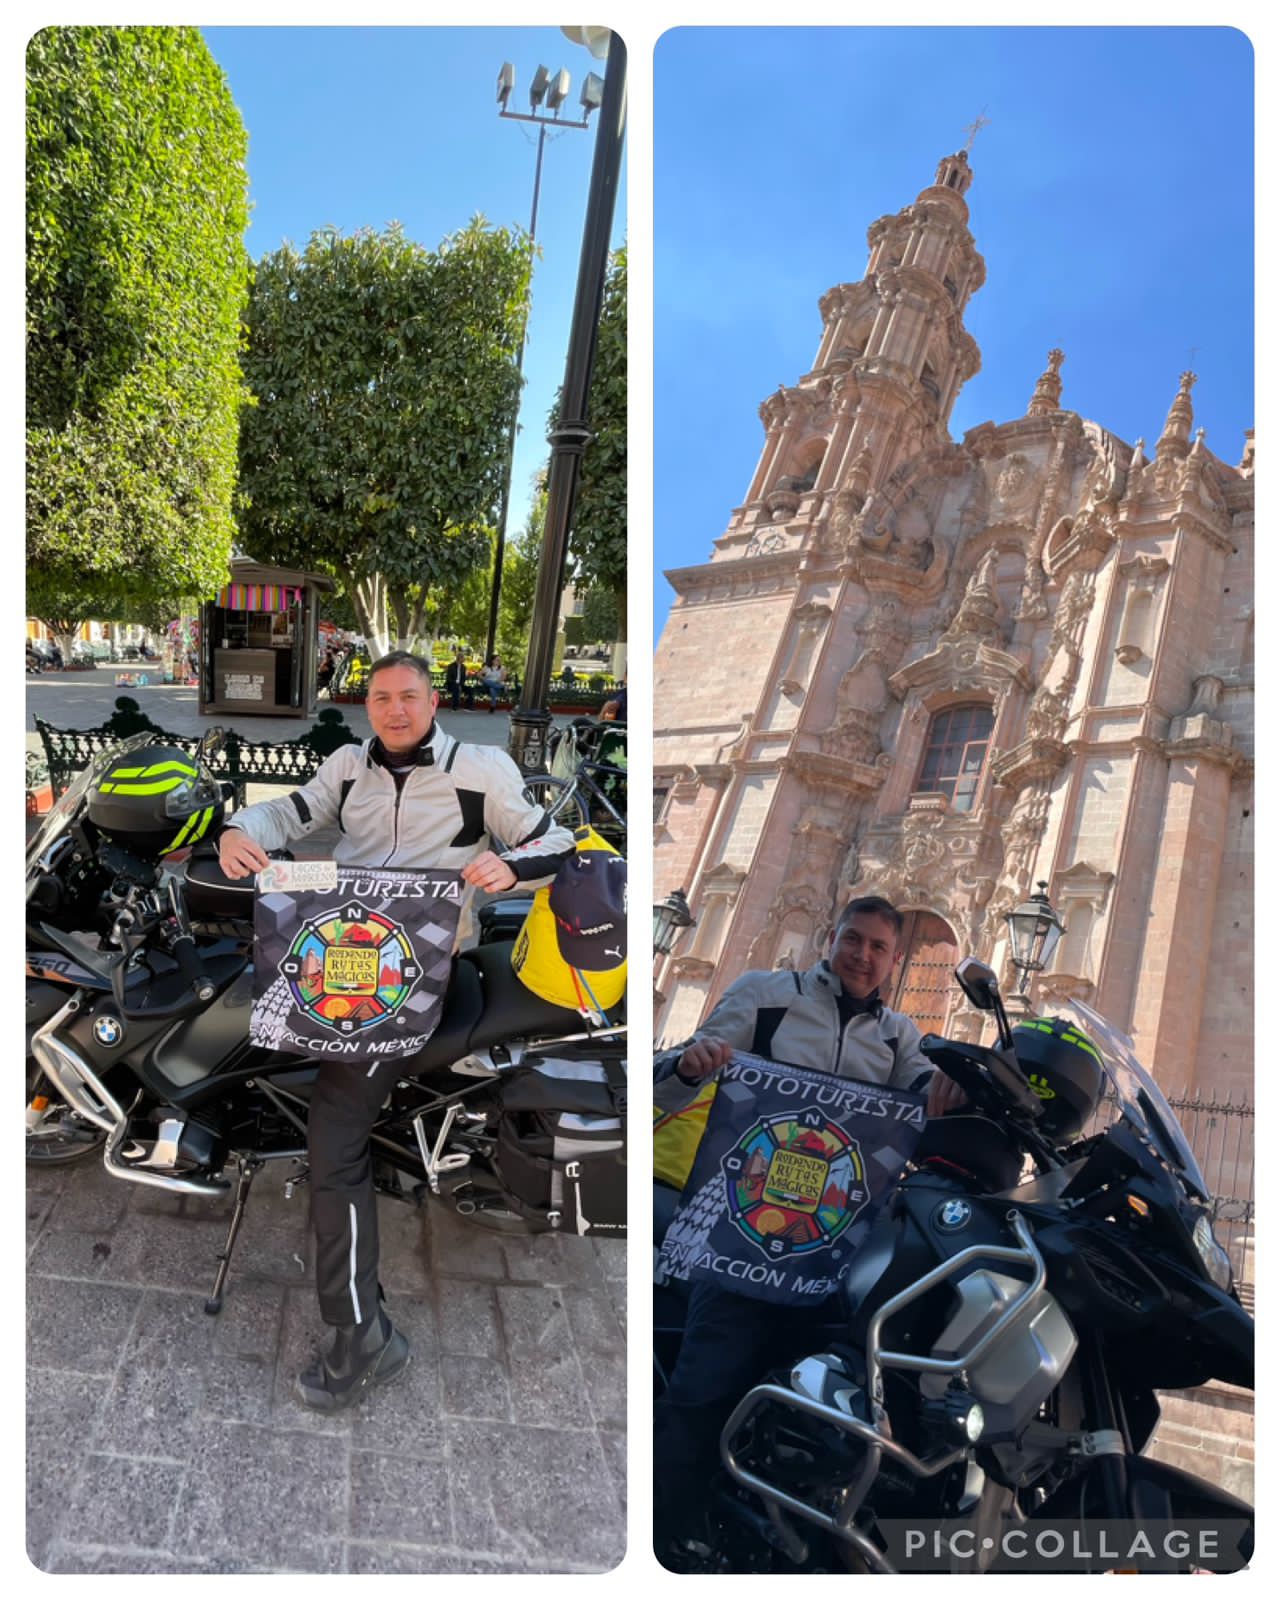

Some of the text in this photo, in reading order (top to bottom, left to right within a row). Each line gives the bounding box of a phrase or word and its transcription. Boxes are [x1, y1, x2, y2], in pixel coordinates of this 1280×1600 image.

[347, 908, 362, 919] N
[404, 966, 416, 977] E
[341, 1021, 353, 1030] S
[281, 1032, 360, 1054] ACCIÓN
[366, 1028, 435, 1054] MÉXIC
[721, 1063, 924, 1124] MOTOTURISTA
[804, 1114, 820, 1126] N
[851, 1190, 864, 1201] E
[770, 1240, 785, 1252] S
[696, 1252, 787, 1289] ACCIÓN
